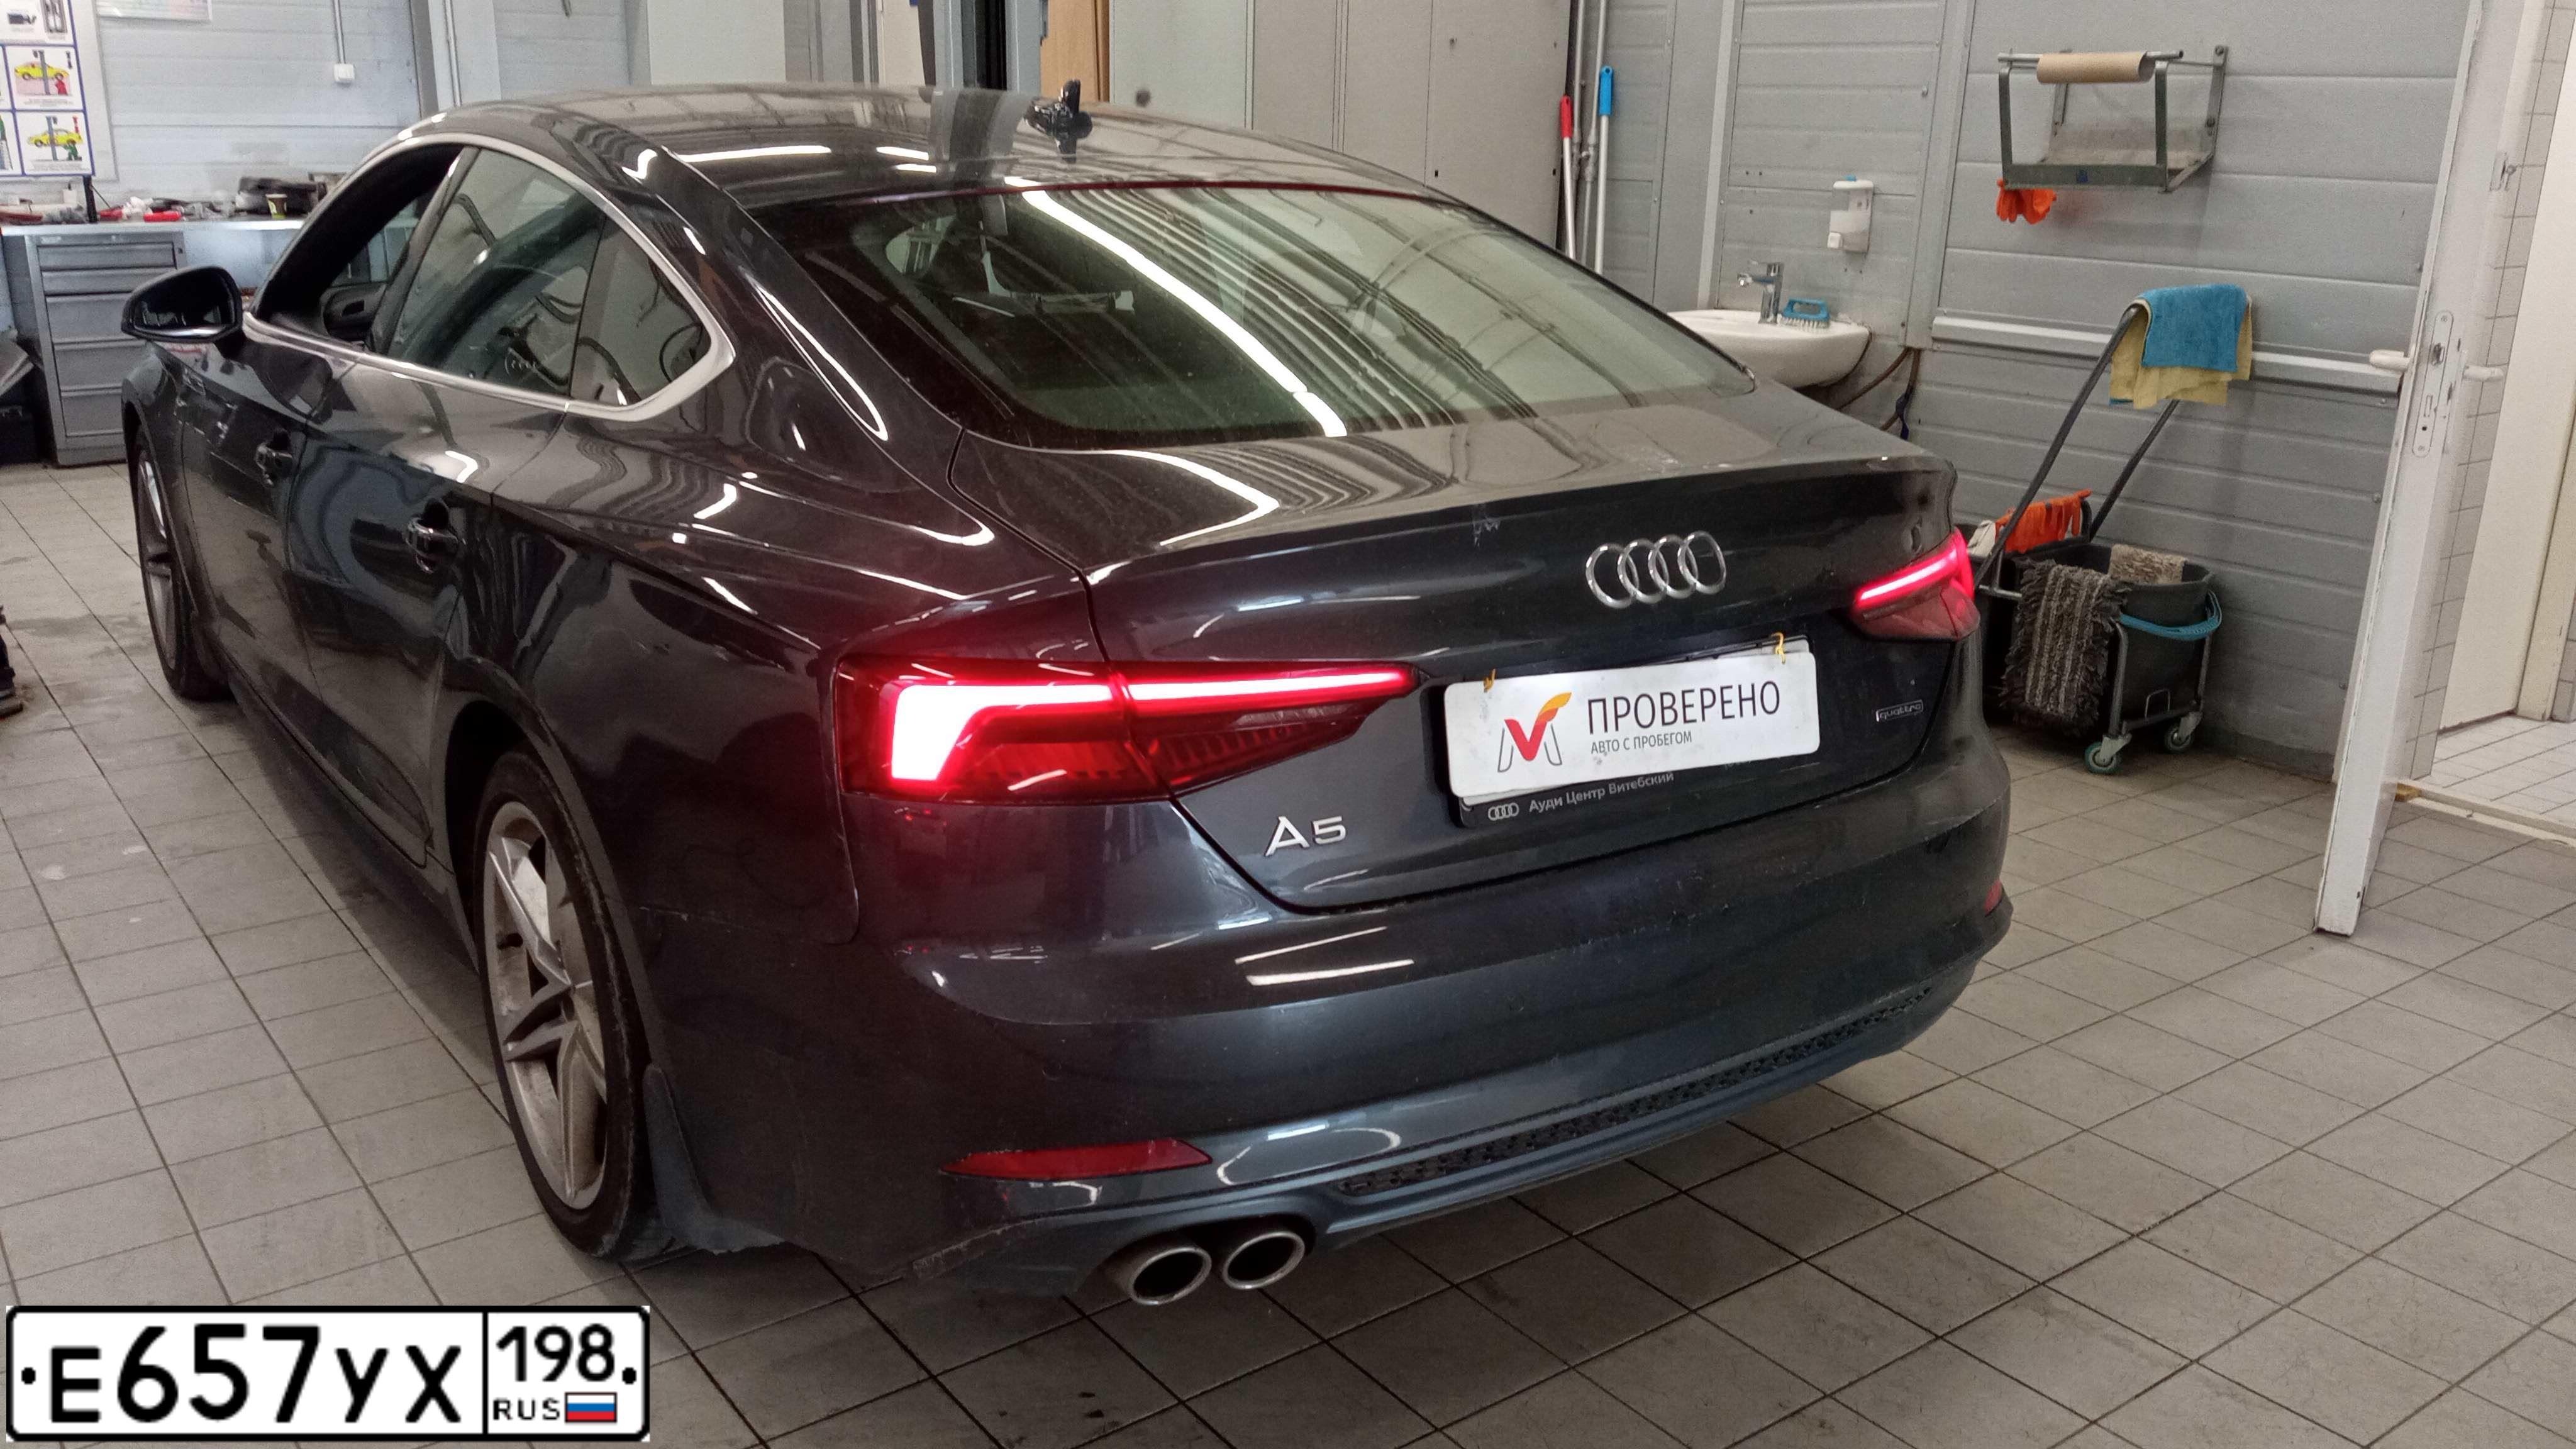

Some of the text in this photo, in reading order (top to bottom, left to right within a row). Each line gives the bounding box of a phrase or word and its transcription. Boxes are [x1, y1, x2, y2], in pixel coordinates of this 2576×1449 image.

[1587, 680, 1780, 735] ПРОВЕРЕНО
[1591, 739, 1620, 755] АВТО
[1633, 731, 1692, 749] ПРОБЕГОМ
[1529, 772, 1675, 814] Ауди Центр Витебский
[1264, 816, 1346, 857] A5
